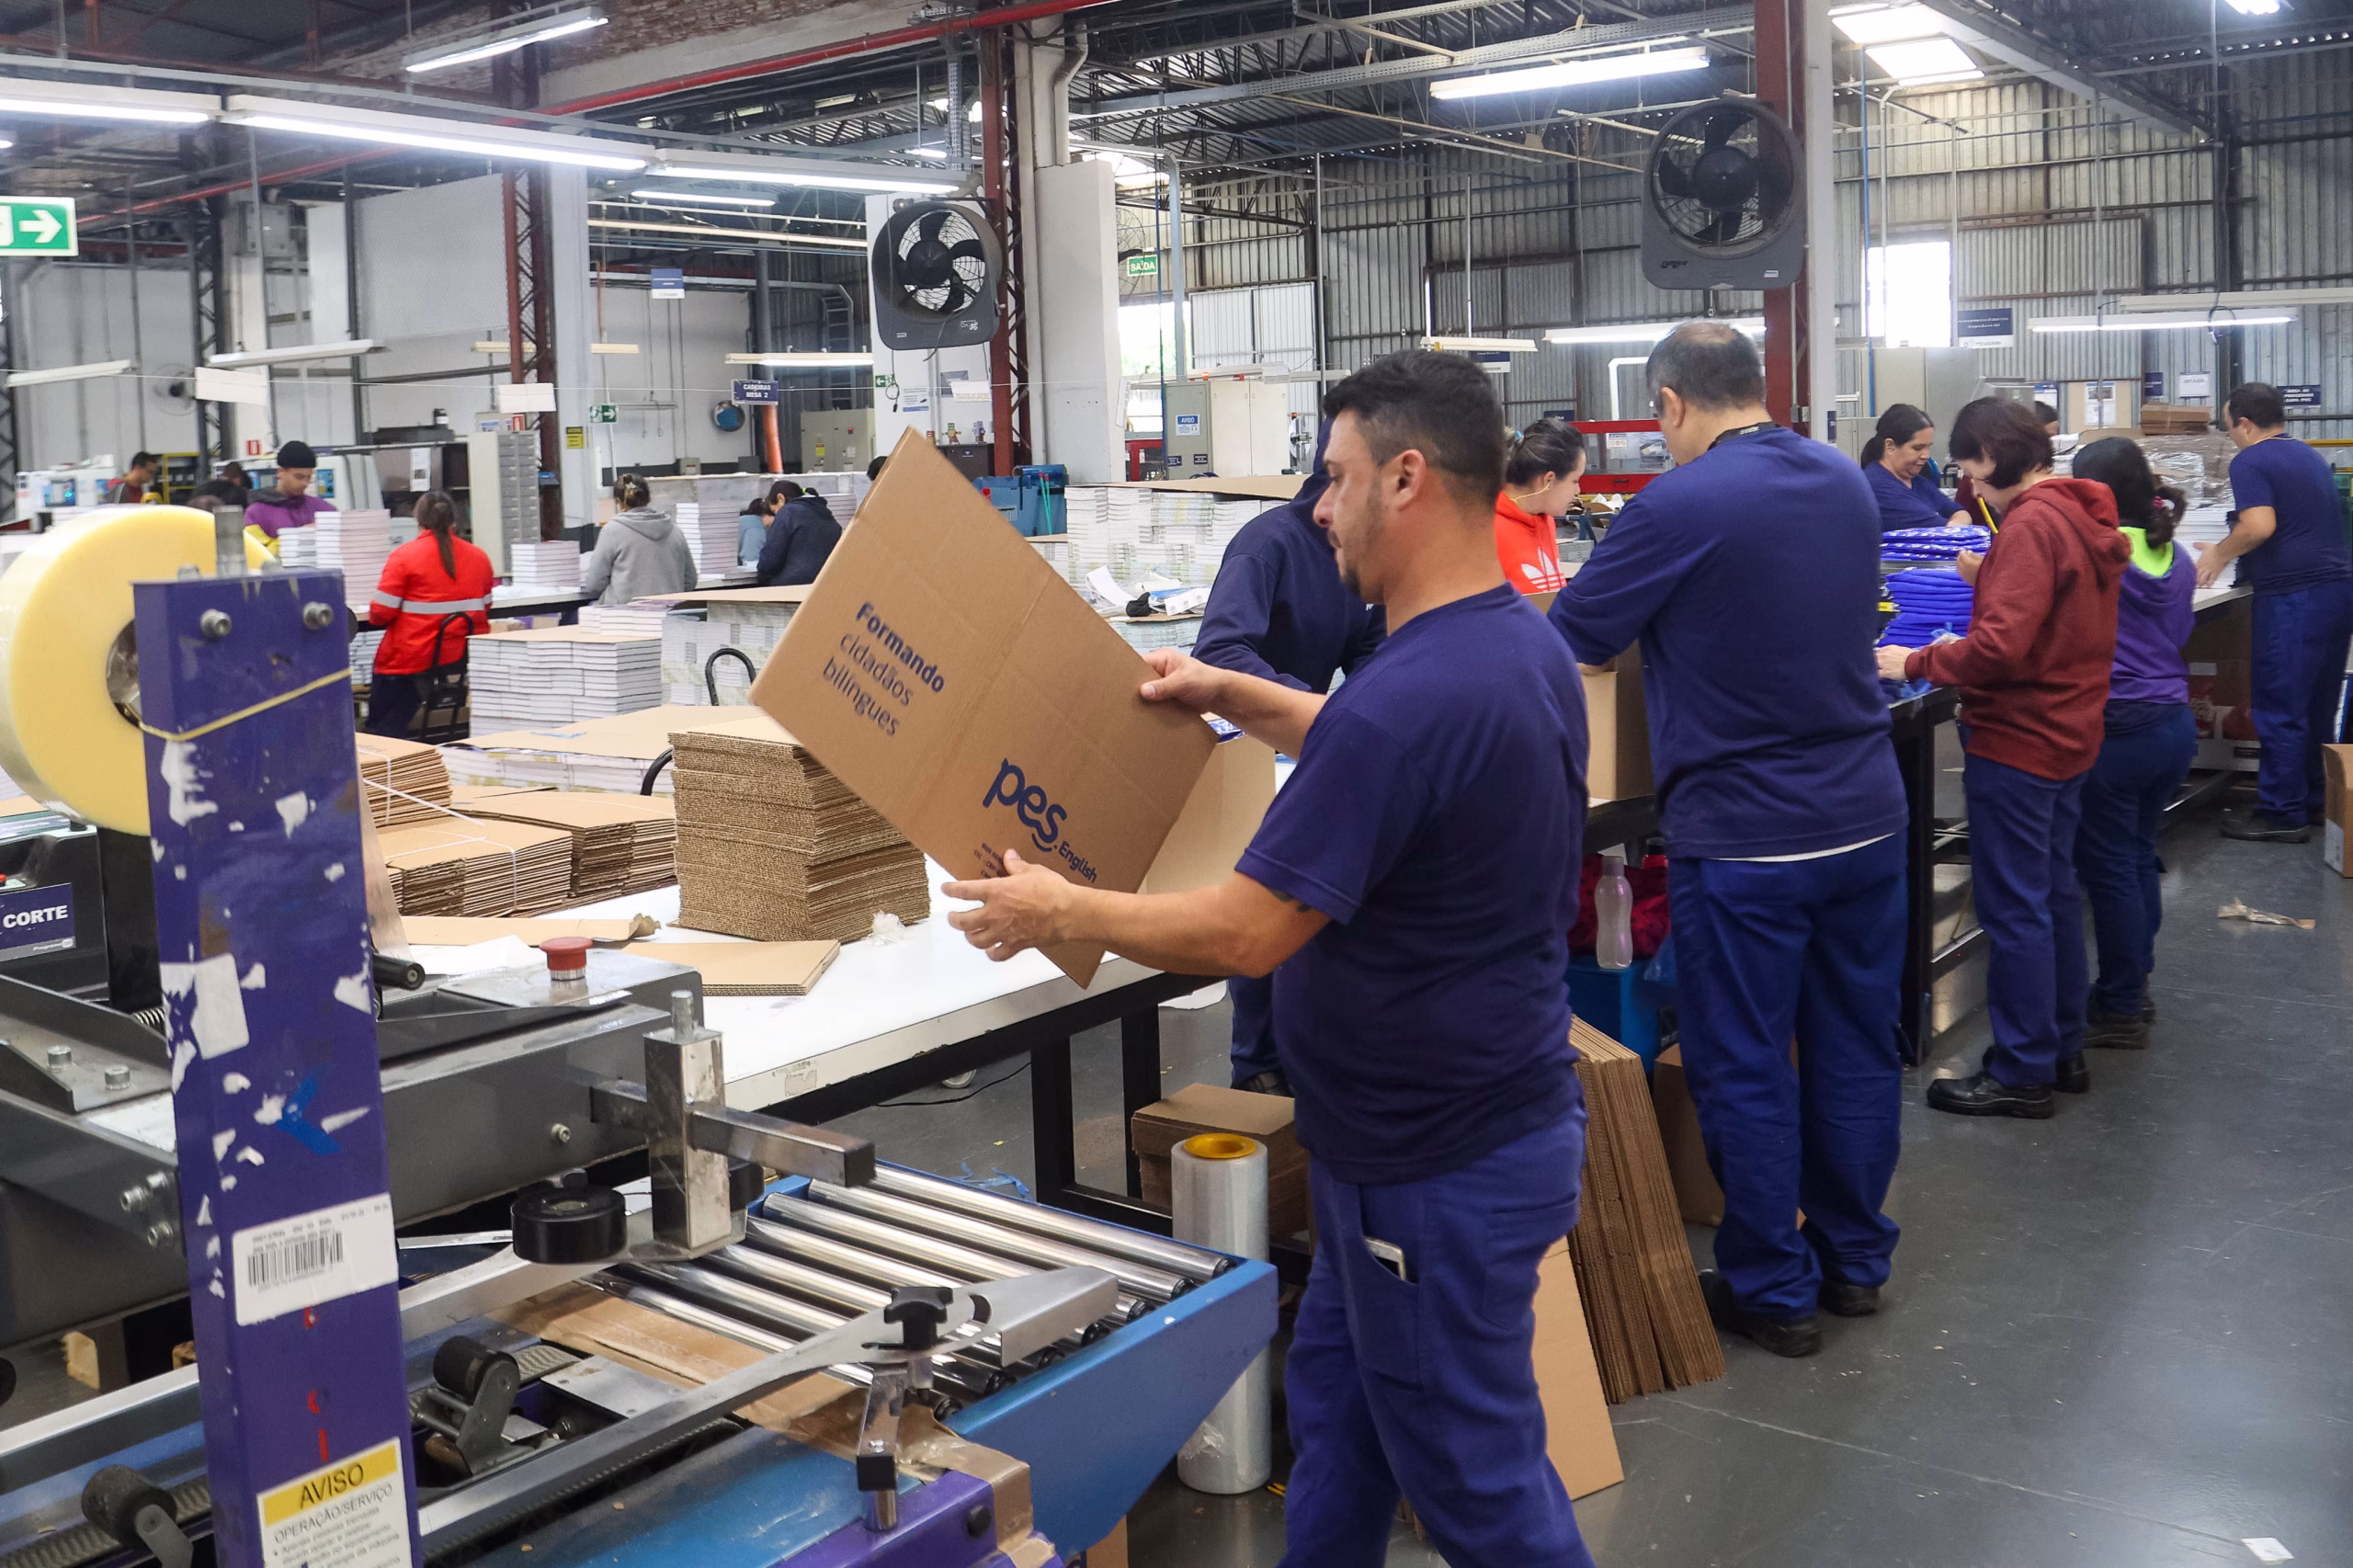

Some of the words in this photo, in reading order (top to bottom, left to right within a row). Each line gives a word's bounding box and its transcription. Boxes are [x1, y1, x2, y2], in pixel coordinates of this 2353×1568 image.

[1131, 261, 1155, 272] SAÍDA
[840, 633, 914, 707] cidadãos
[856, 602, 944, 693] Formando
[983, 757, 1067, 844] pes
[1058, 840, 1098, 883] English
[3, 904, 68, 929] CORTE
[301, 1462, 364, 1509] AVISO
[274, 1483, 392, 1544] OPERAÇÃO/SERVIÇO
